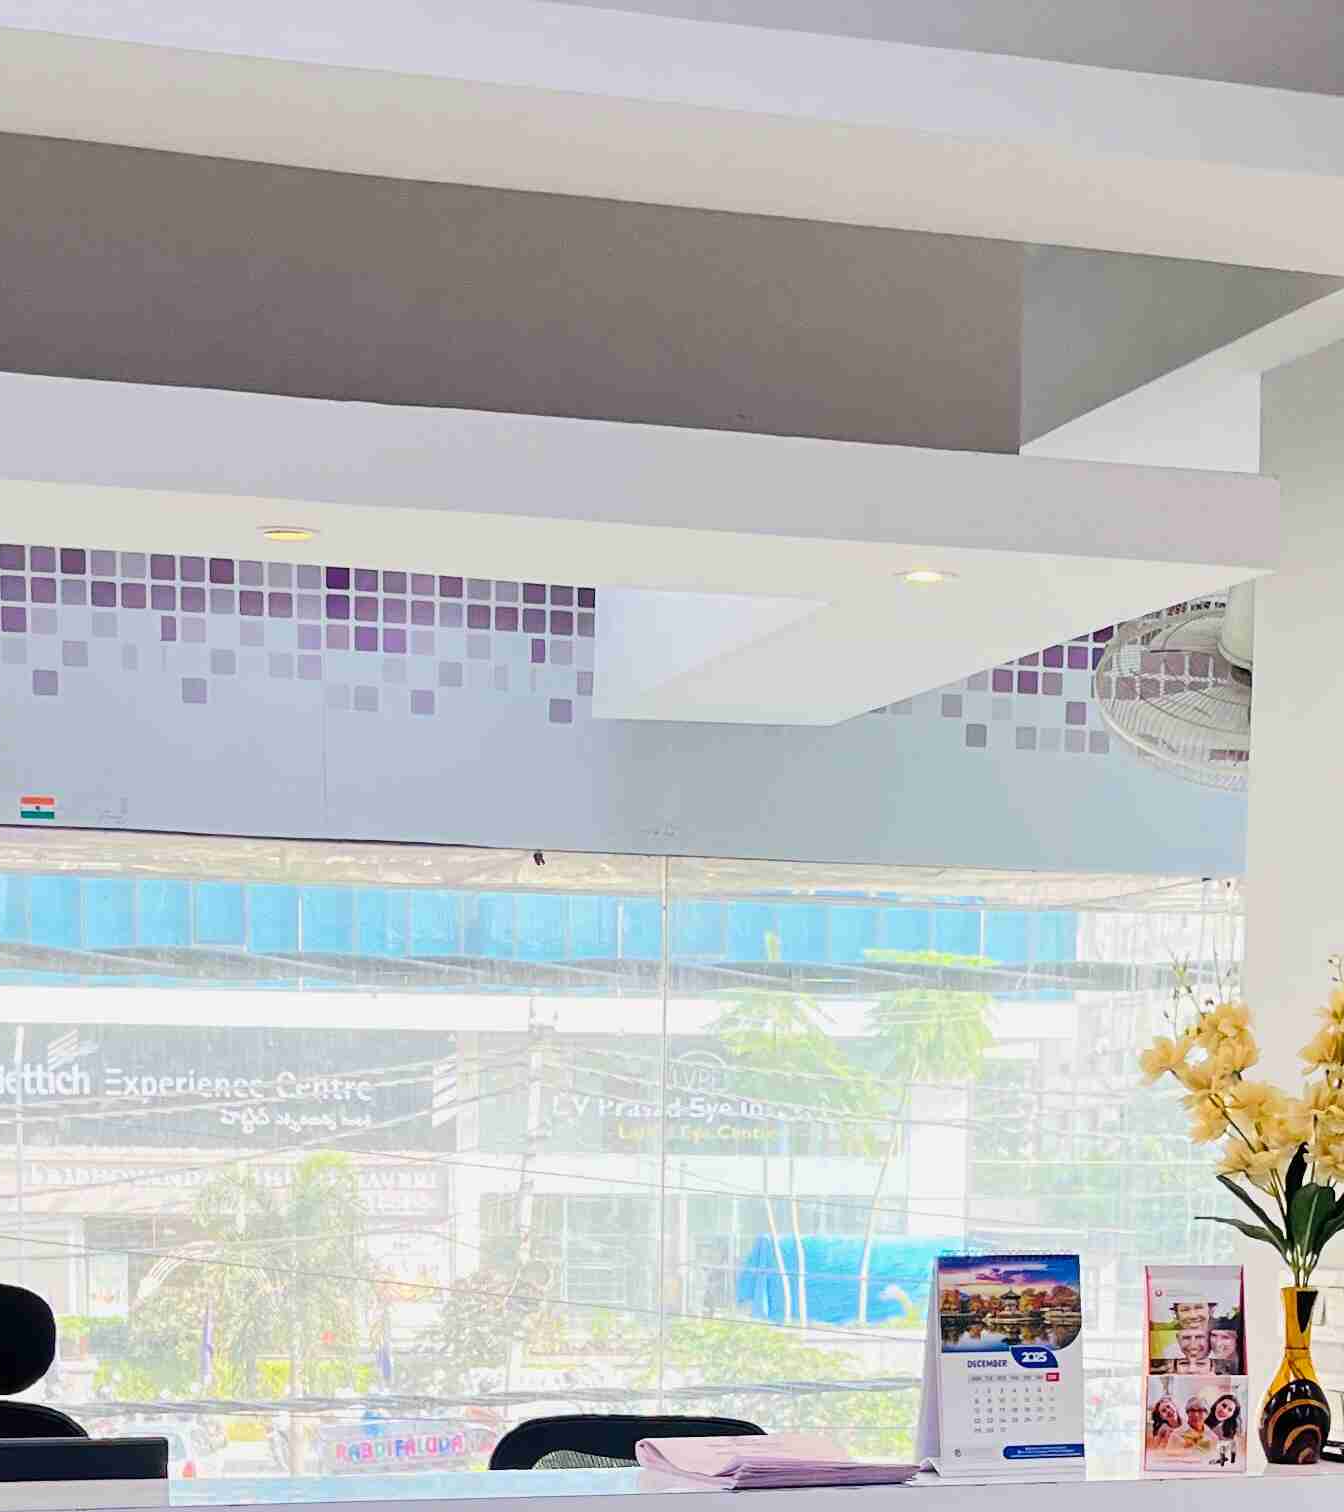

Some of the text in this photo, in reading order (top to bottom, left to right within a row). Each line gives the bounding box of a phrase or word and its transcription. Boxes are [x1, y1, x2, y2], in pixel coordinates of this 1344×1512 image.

[105, 1067, 264, 1101] Experience
[275, 1072, 373, 1103] Centre
[967, 1360, 1008, 1368] DECEMBER
